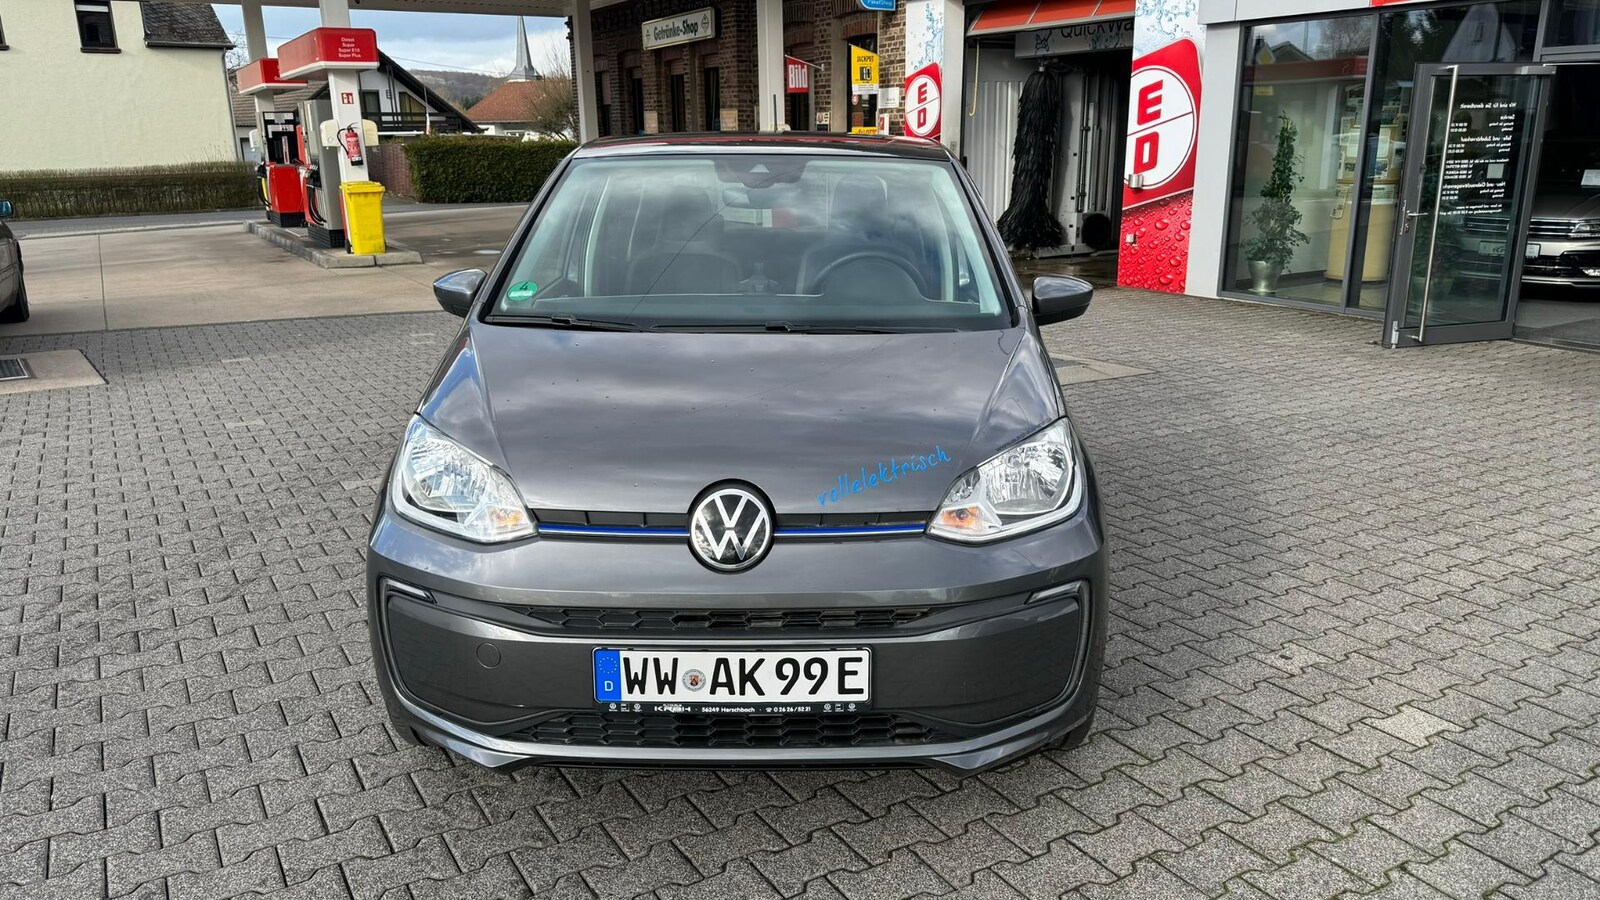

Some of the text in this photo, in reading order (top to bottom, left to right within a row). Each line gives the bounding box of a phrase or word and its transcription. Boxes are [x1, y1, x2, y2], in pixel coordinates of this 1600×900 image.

[653, 19, 699, 41] Getränke-Shop
[788, 64, 808, 88] Bild
[520, 281, 529, 291] 4
[816, 444, 952, 507] vollelektrisch
[604, 680, 614, 692] D
[622, 656, 865, 696] WW AK 99 E
